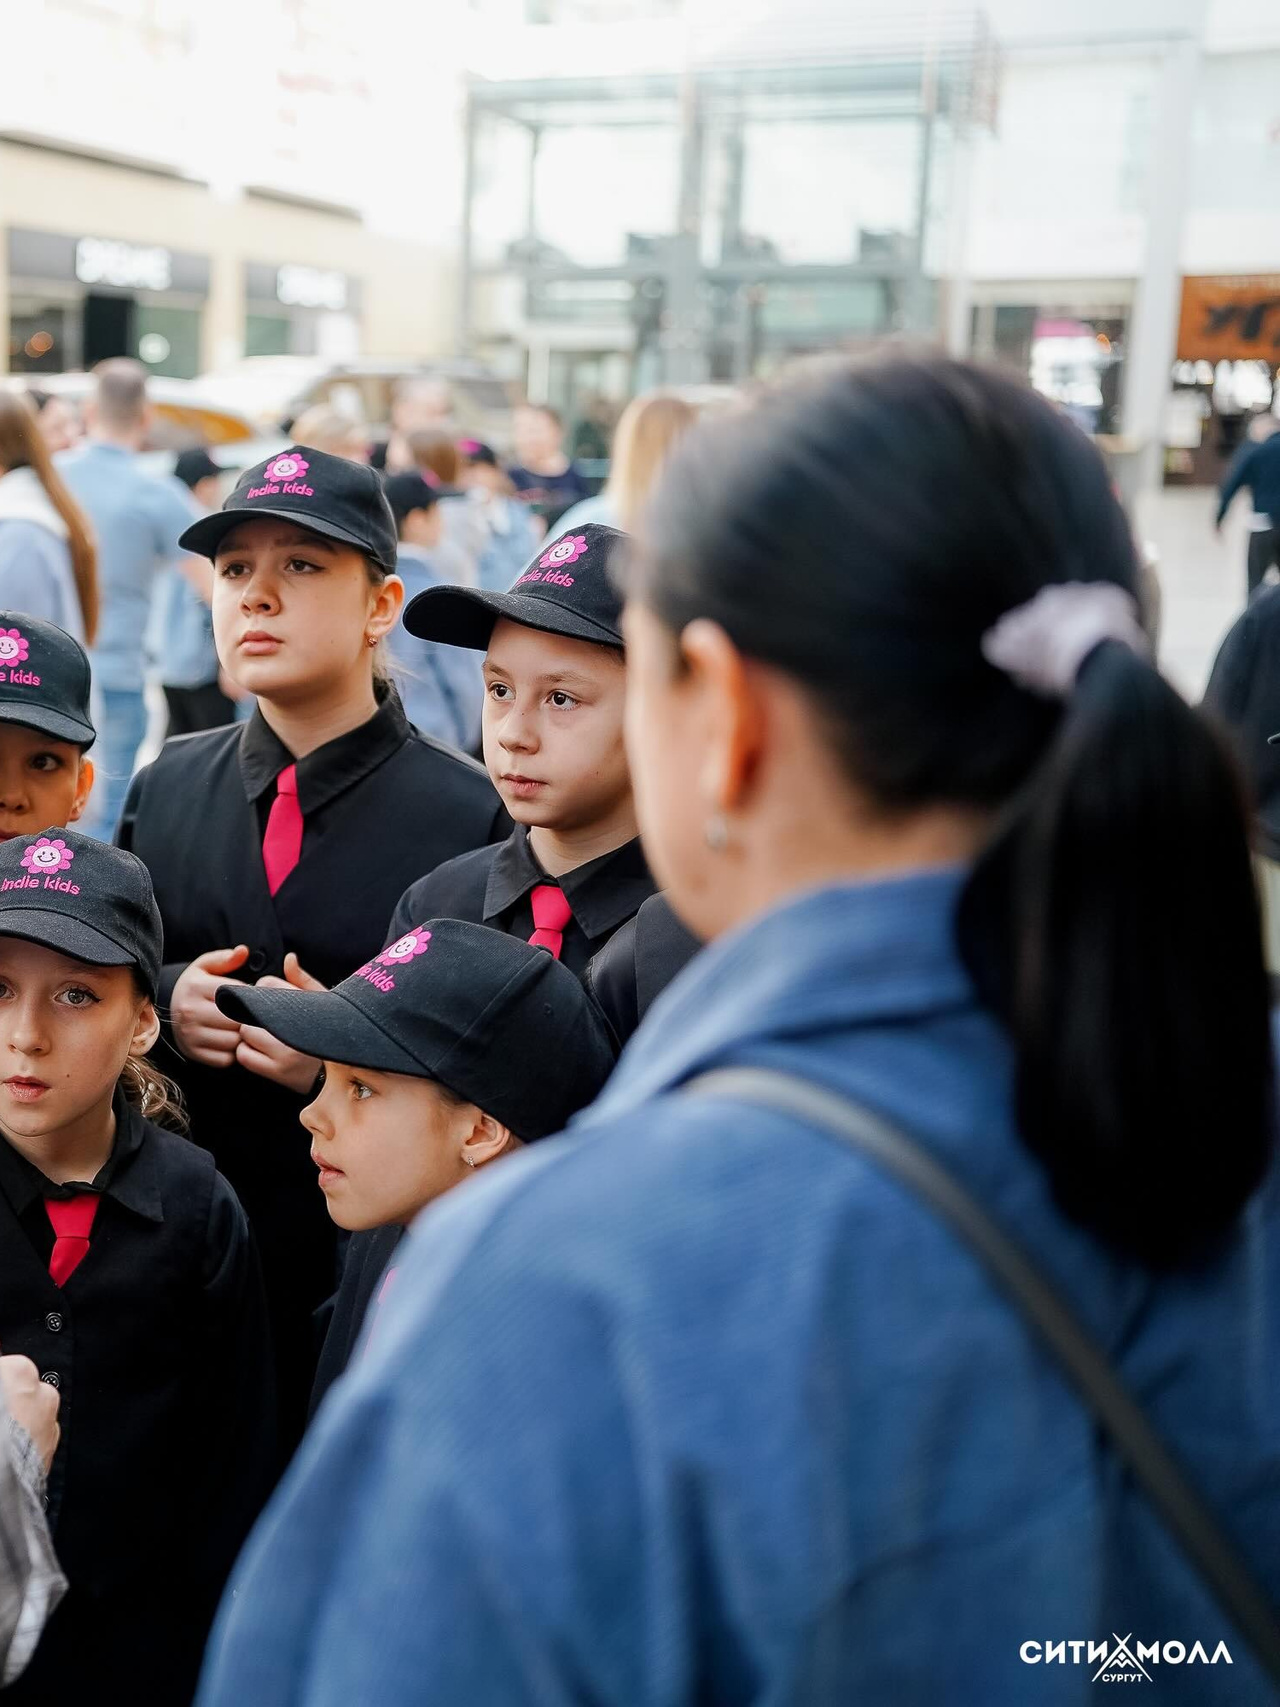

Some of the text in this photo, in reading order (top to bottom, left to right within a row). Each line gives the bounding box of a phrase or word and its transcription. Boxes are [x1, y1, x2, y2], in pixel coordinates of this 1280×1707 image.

[246, 482, 314, 499] indie kids
[542, 569, 575, 588] kids
[9, 669, 42, 687] kids
[0, 875, 81, 895] indie kids
